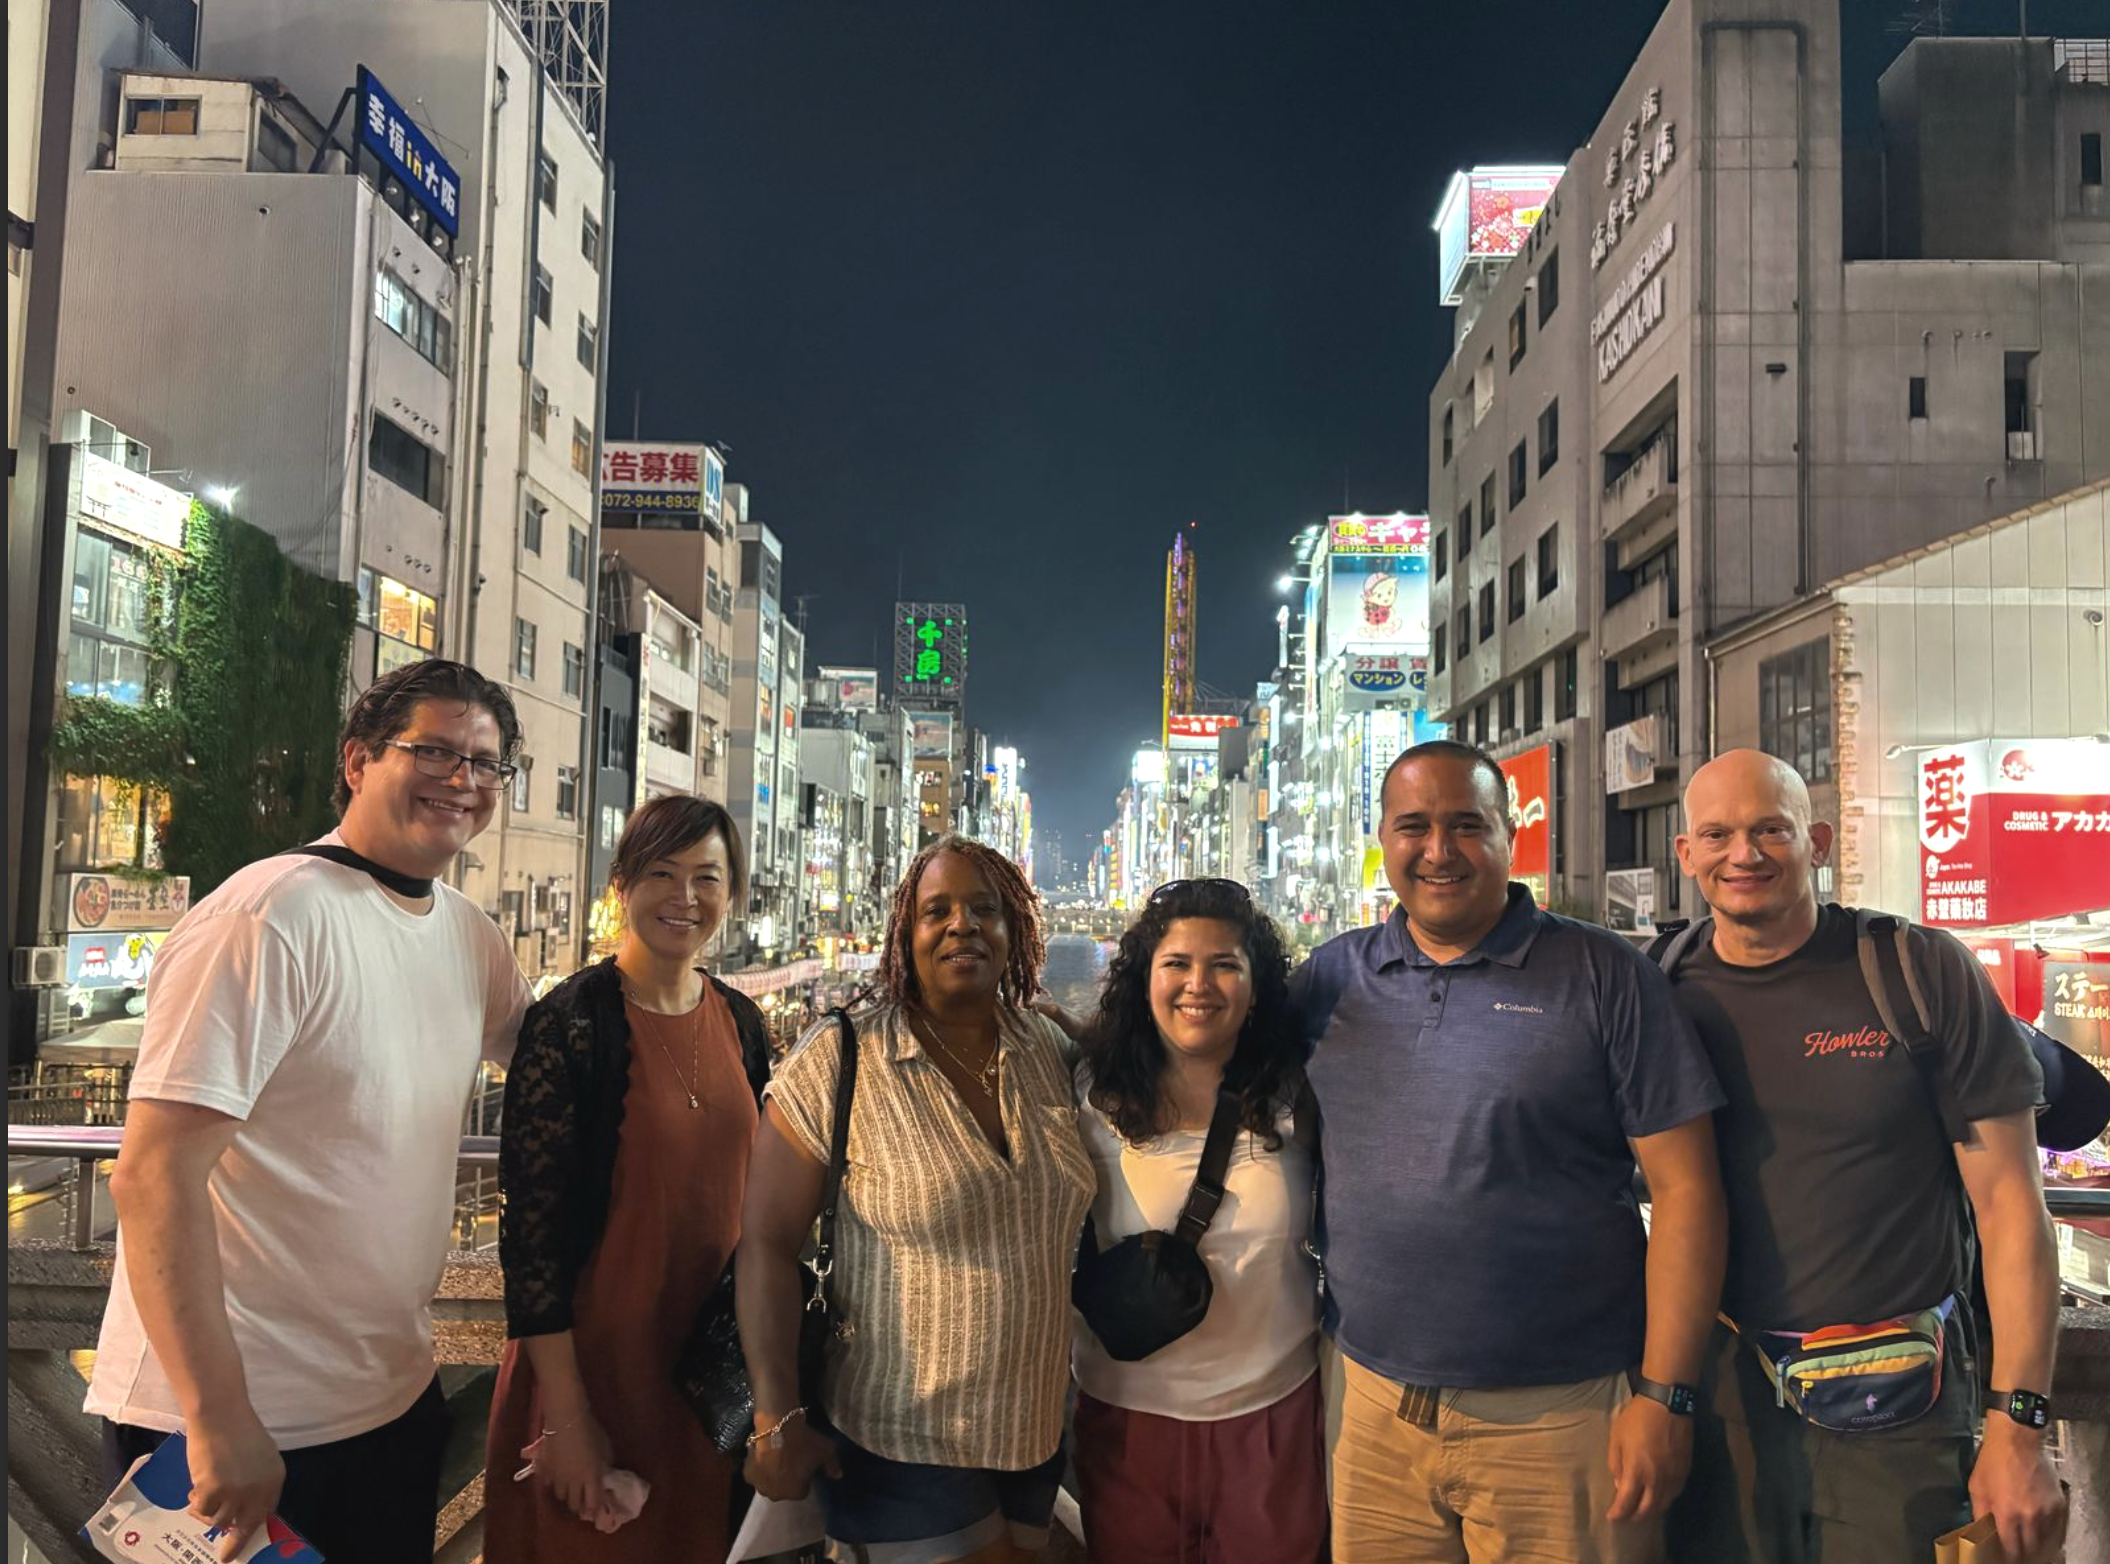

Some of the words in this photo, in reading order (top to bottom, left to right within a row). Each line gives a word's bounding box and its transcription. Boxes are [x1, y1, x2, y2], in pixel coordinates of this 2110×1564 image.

[1354, 671, 1405, 685] マンション
[1923, 754, 1968, 839] 薬
[2012, 811, 2038, 821] DRUG
[2004, 821, 2050, 832] COSMETIC
[1941, 879, 1987, 895] AKAKABE
[1503, 1003, 1543, 1014] Columbia
[2054, 1002, 2087, 1018] STEAK
[1804, 1025, 1889, 1057] Howler
[1850, 1050, 1885, 1058] BROS
